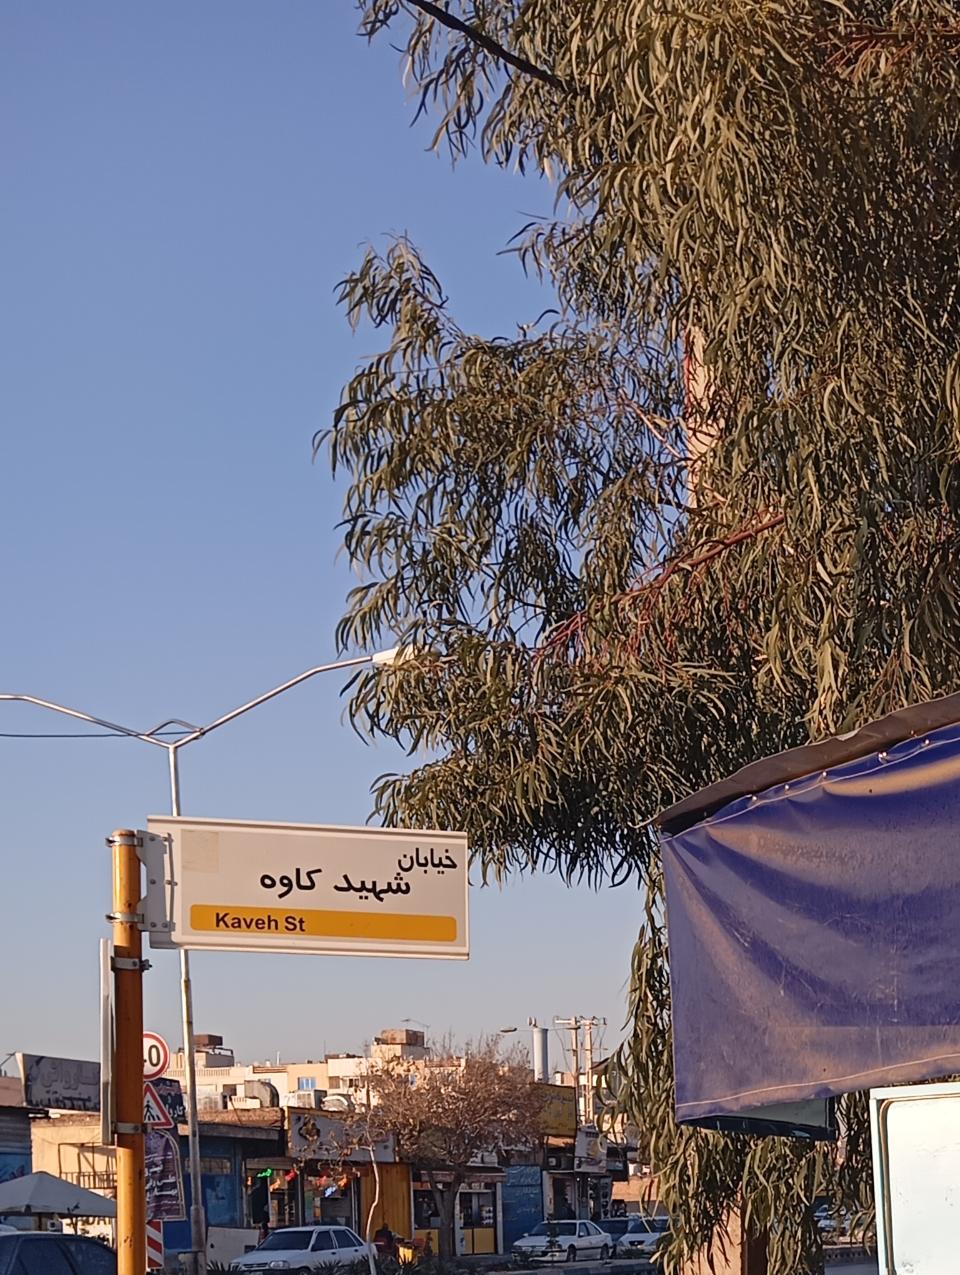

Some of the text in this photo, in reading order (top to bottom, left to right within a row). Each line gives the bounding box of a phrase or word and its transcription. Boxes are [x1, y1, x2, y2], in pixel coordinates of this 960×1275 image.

[398, 847, 458, 874] خیابان
[259, 867, 411, 902] شهید کاوه
[214, 912, 306, 932] Kaveh St
